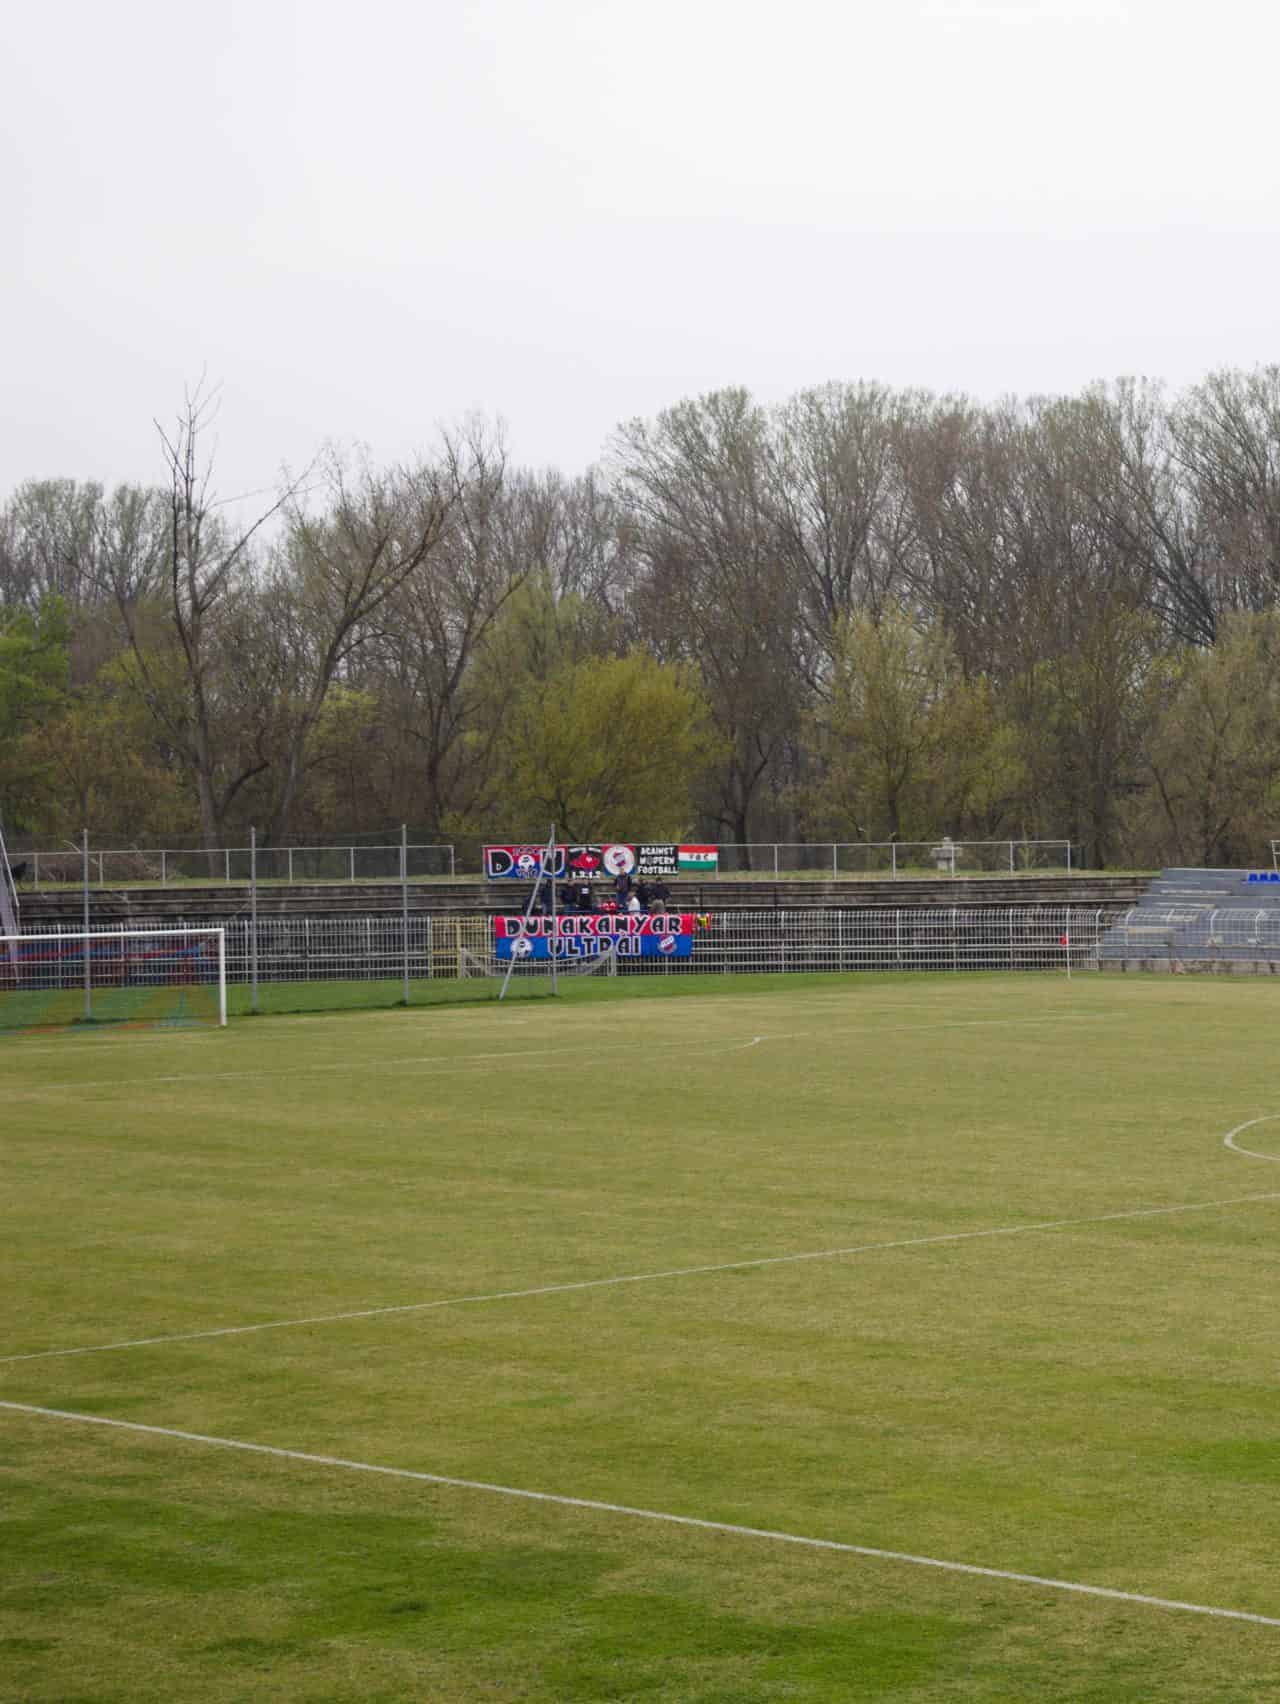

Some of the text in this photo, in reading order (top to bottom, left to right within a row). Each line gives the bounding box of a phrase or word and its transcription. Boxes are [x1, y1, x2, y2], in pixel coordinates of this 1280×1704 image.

[640, 847, 673, 855] AGAINST
[638, 866, 678, 874] FOOTBALL
[504, 914, 682, 936] DUNAKANYAR
